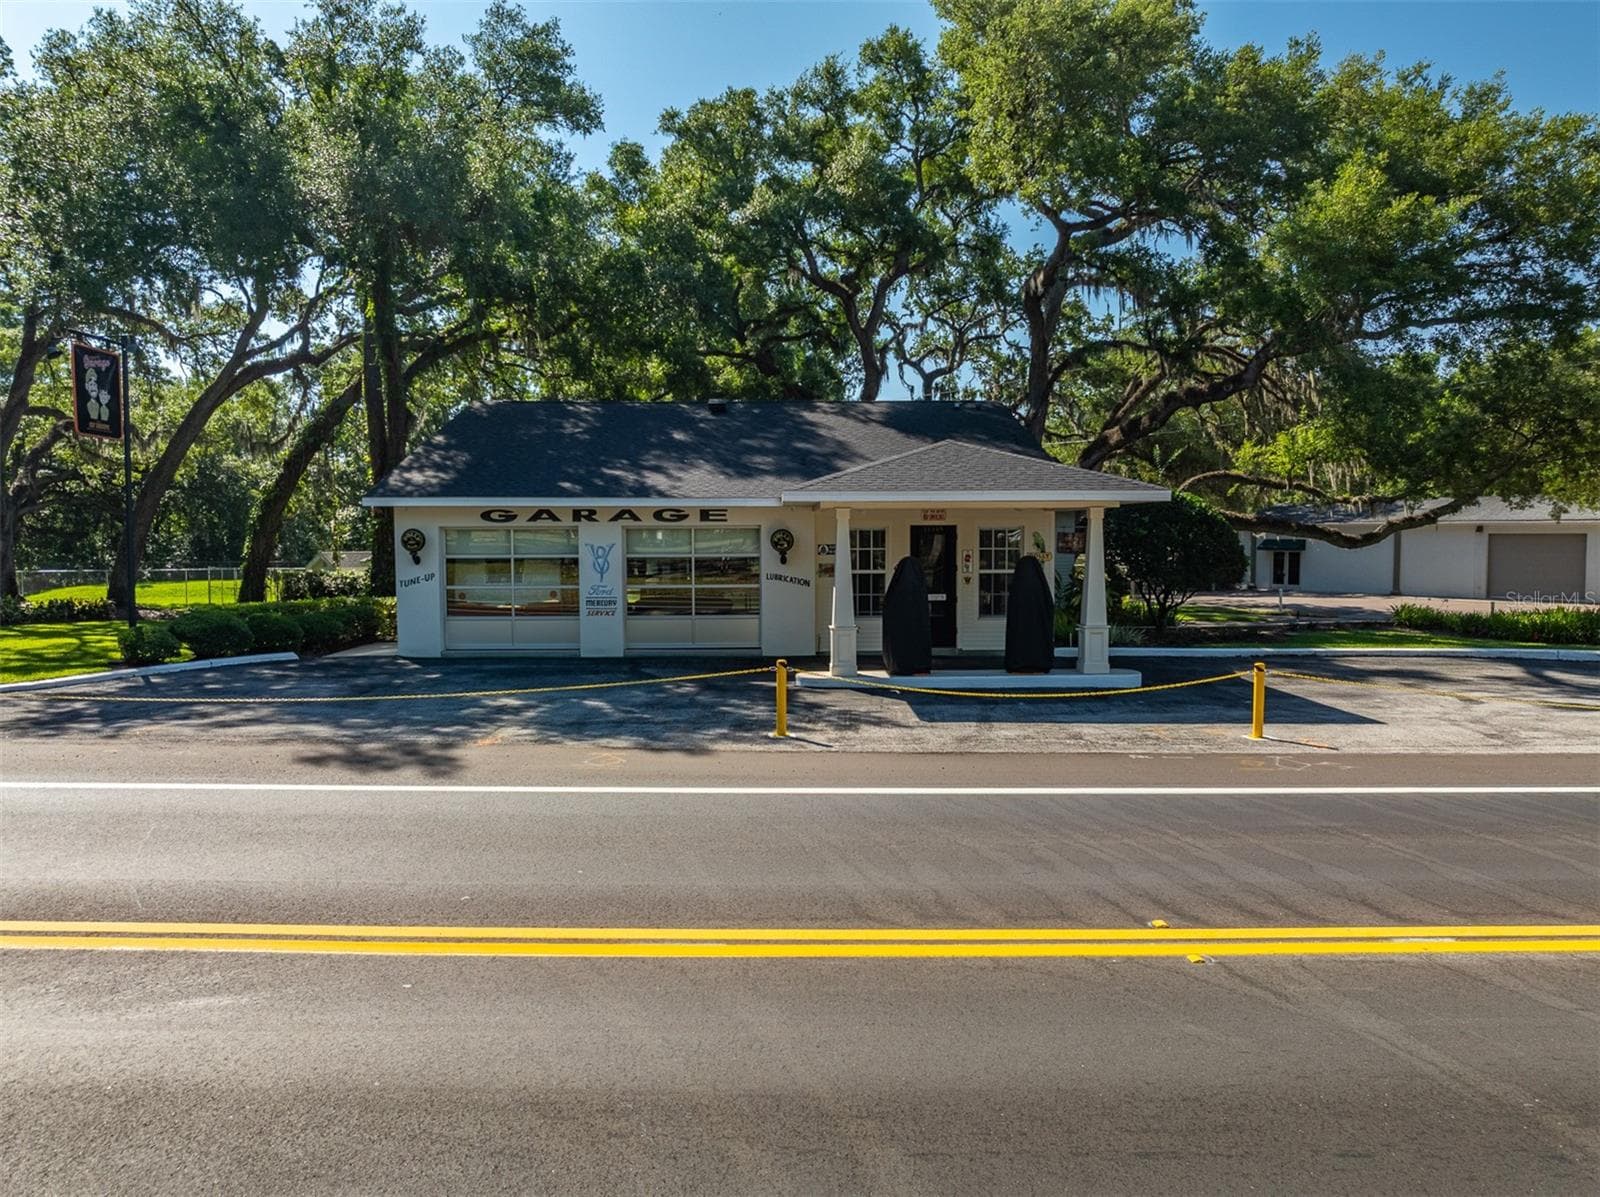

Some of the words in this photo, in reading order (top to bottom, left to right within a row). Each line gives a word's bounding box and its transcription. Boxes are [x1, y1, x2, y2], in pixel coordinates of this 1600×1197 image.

[480, 508, 729, 523] GARAGE
[399, 573, 436, 588] TUNE-UP
[766, 573, 811, 587] LUBRICATION
[588, 584, 615, 595] Ford
[586, 599, 618, 607] MERCURY
[586, 609, 617, 617] SERVICE
